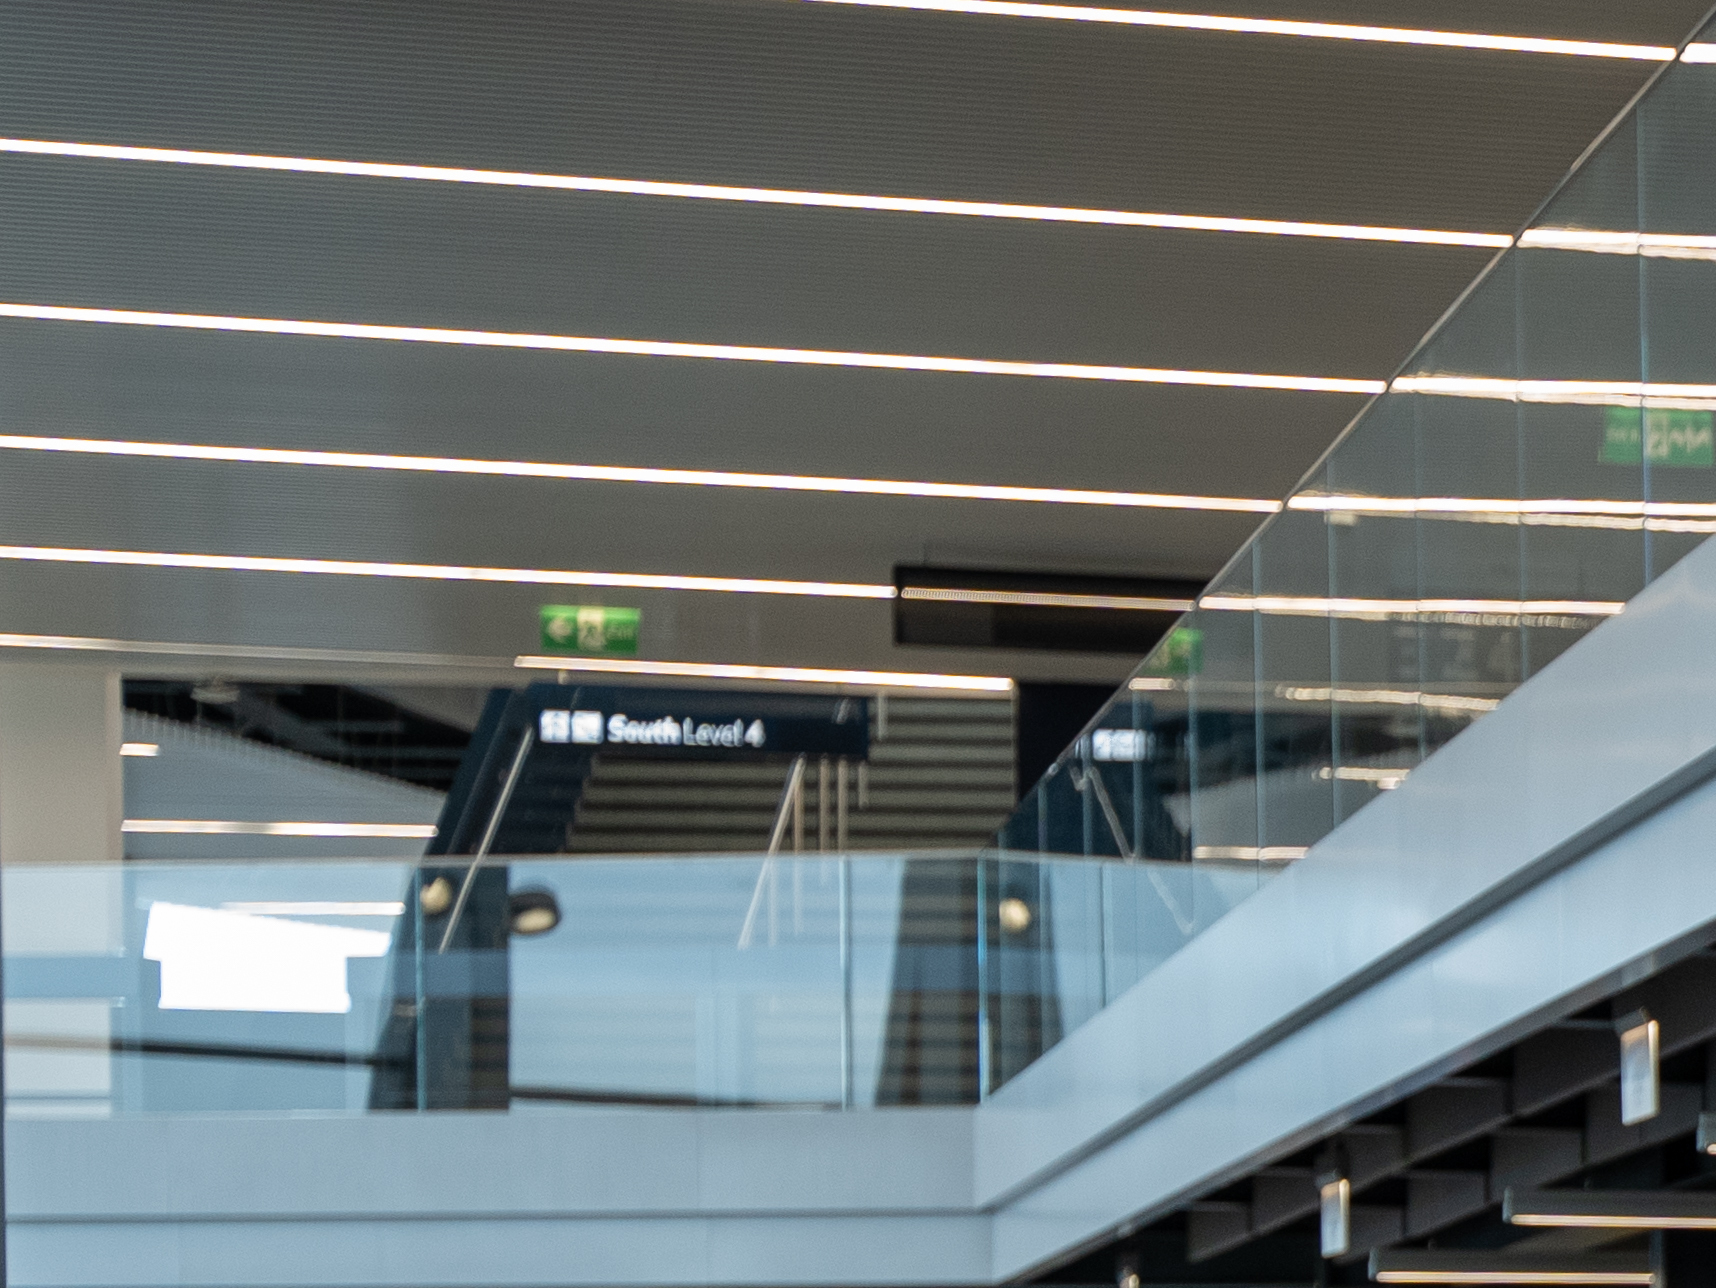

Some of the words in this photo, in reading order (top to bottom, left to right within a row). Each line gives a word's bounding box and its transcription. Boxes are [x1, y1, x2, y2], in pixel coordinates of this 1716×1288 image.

[607, 713, 682, 746] South
[683, 716, 744, 747] Level
[744, 718, 767, 748] 4
